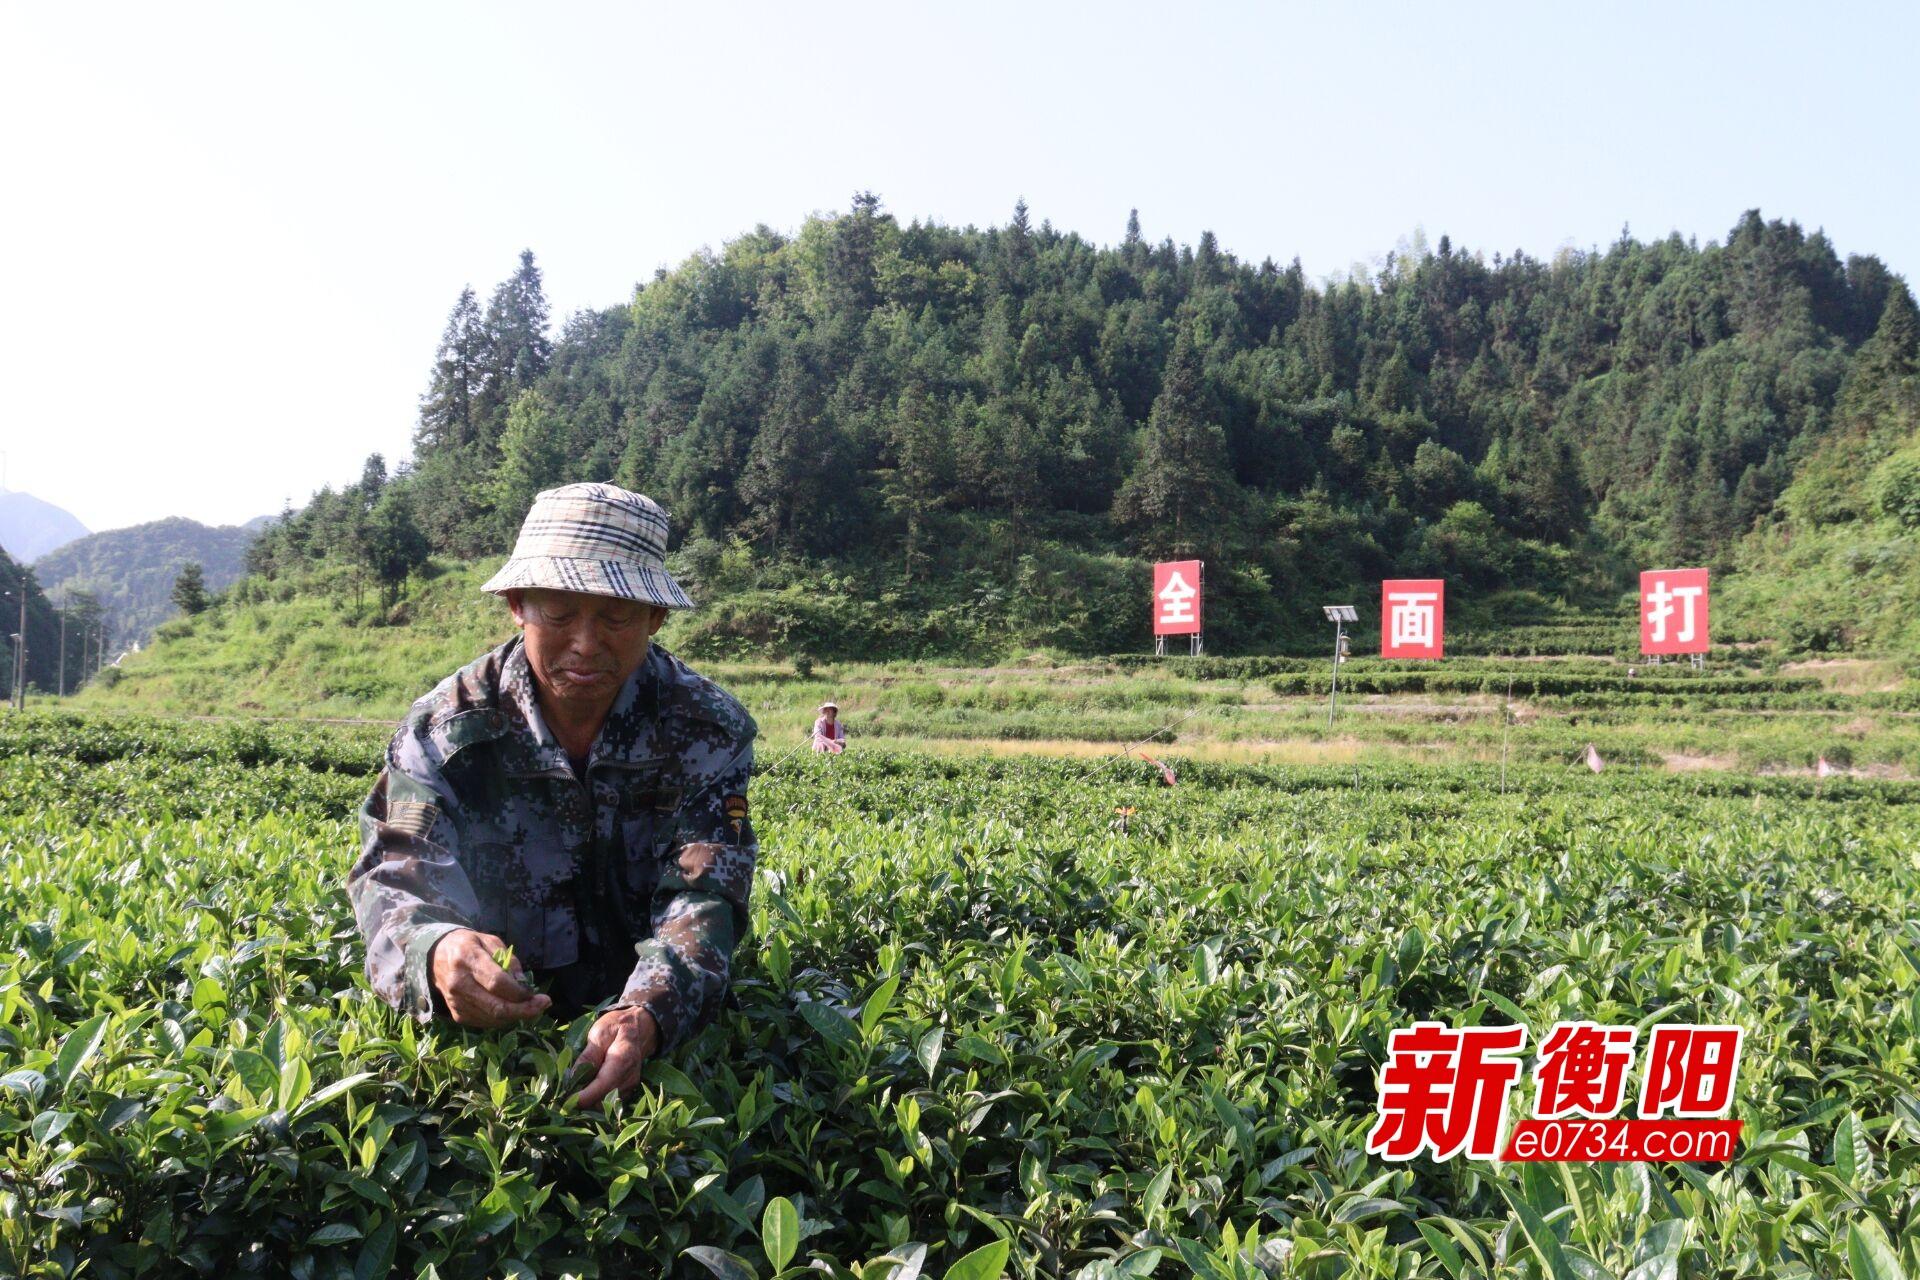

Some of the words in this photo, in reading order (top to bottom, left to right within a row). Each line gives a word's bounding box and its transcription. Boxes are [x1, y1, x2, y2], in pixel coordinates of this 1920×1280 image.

[1157, 570, 1197, 625] 全
[1387, 591, 1438, 649] 面
[1646, 580, 1704, 643] 打
